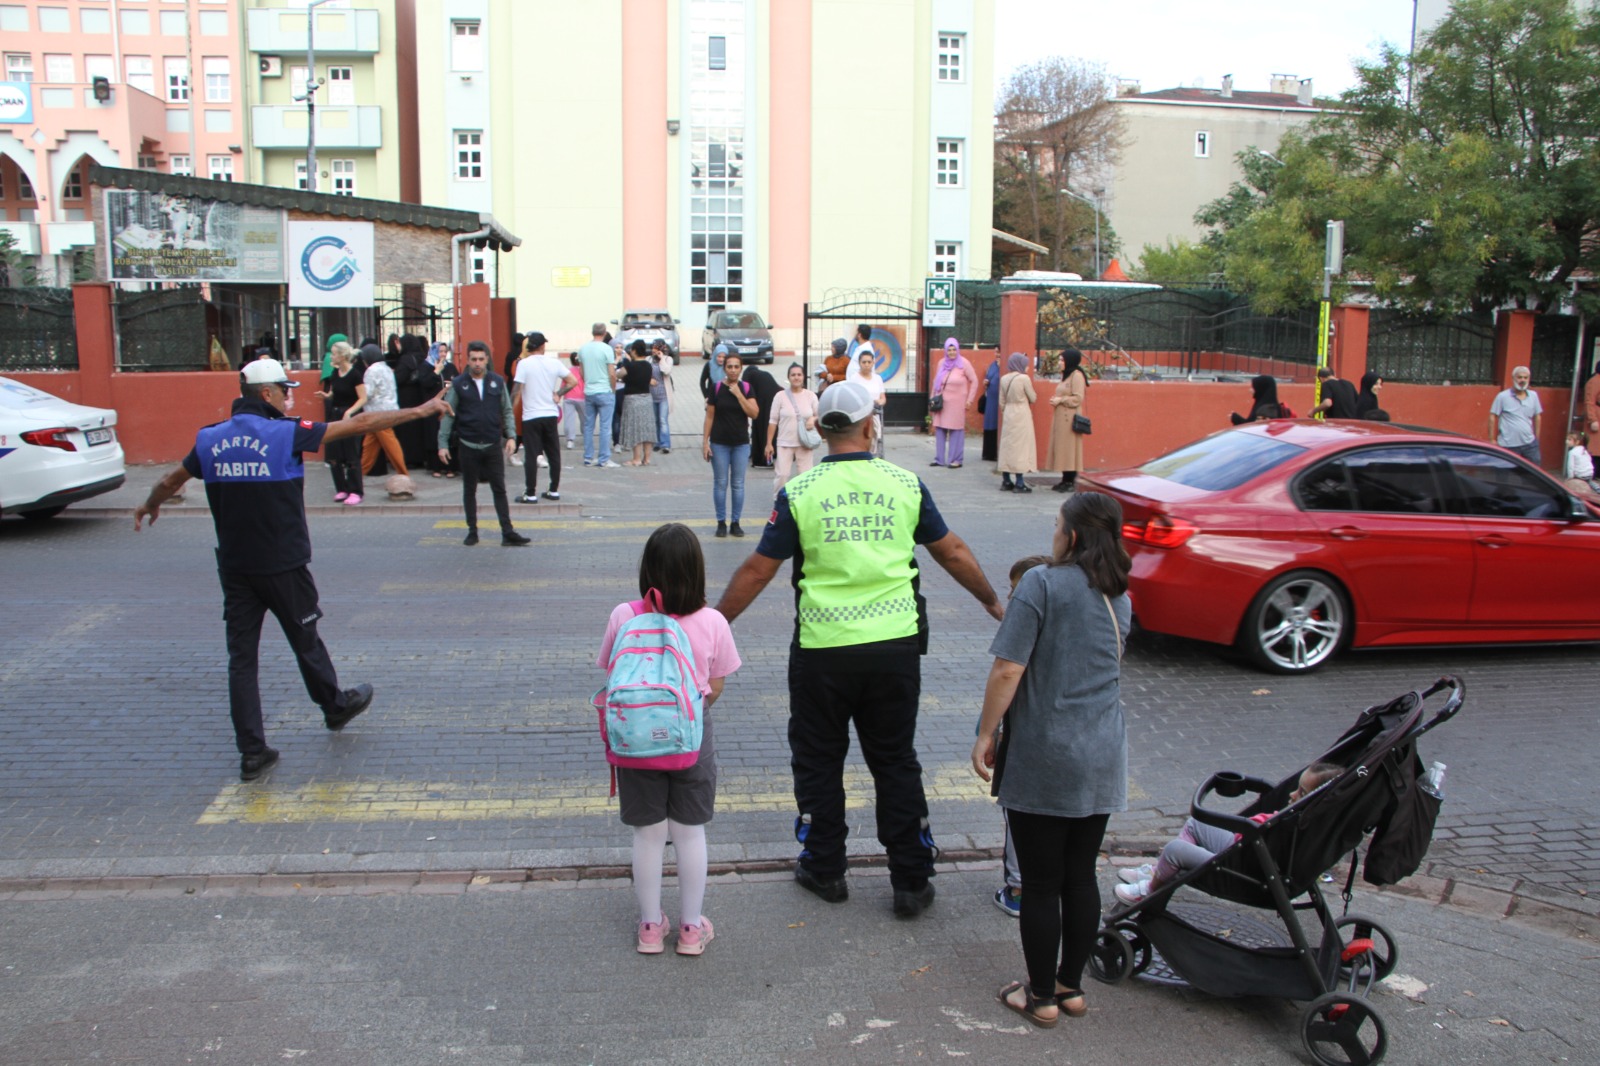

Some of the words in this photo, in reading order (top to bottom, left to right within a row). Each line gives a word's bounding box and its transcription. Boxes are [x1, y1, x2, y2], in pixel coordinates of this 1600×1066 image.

[211, 435, 269, 457] KARTAL
[214, 462, 271, 477] ZABITA
[820, 491, 896, 513] KARTAL
[821, 513, 895, 529] TRAFİK
[824, 529, 894, 543] ZABITA
